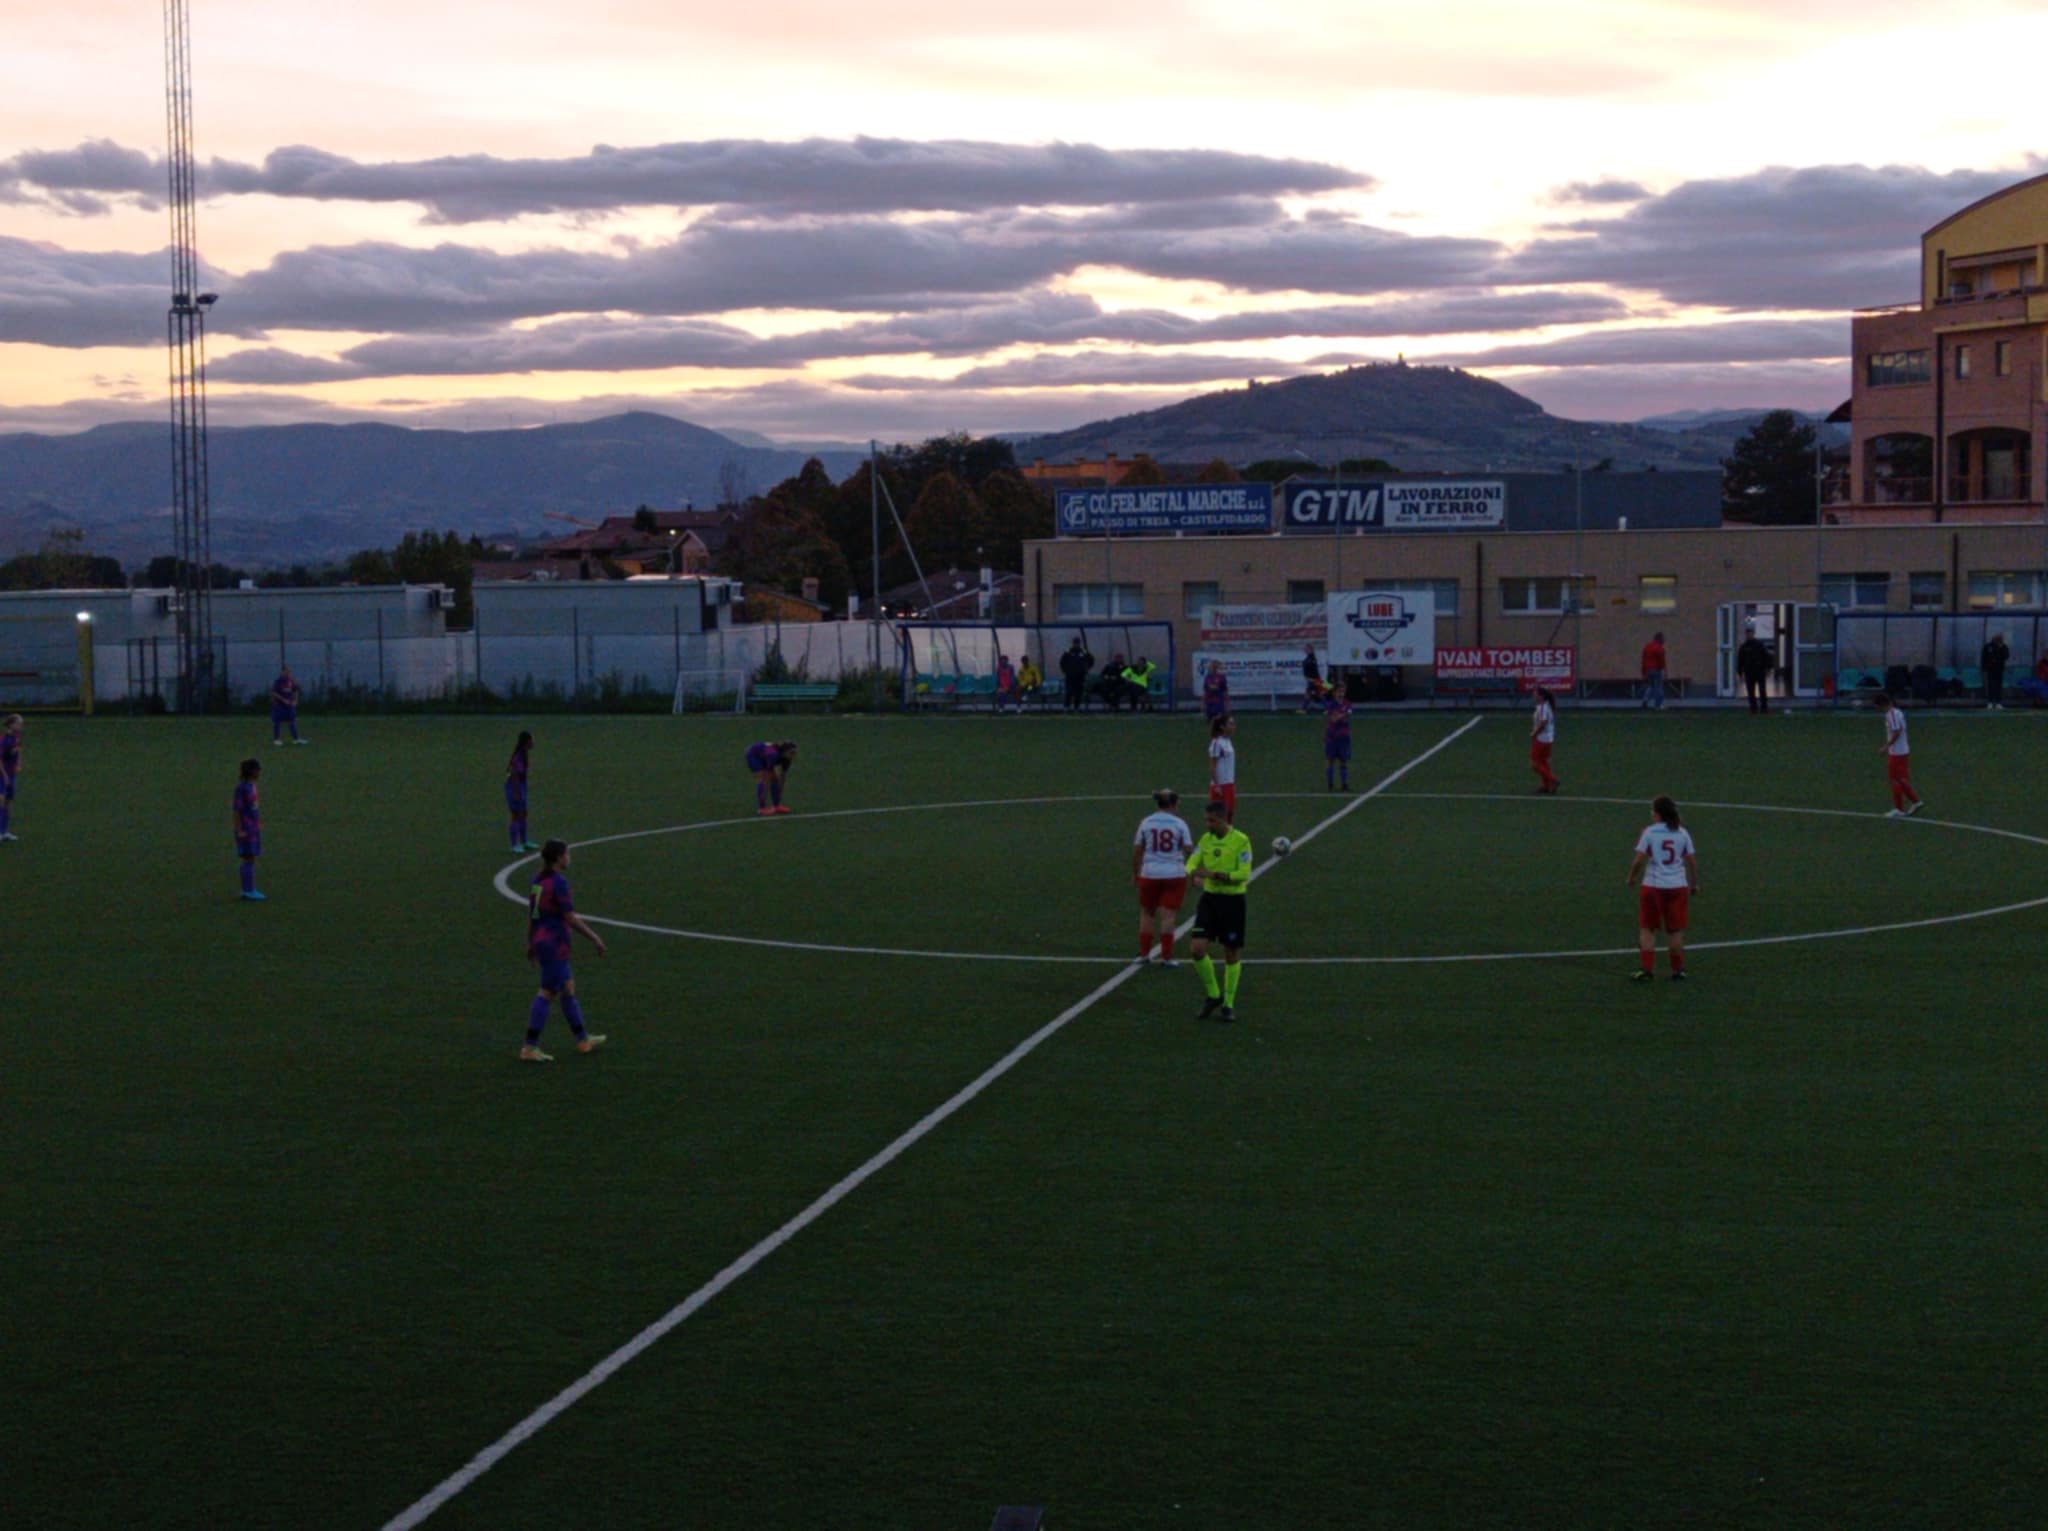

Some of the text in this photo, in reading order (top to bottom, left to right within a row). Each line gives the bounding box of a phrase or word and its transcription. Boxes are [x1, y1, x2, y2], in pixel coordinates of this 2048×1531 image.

[1187, 489, 1247, 512] MARCHE
[1291, 488, 1380, 523] GTM
[1387, 487, 1502, 501] LAVORAZIONI
[1399, 501, 1489, 515] IN FERRO
[1437, 649, 1571, 666] IVAN TOMBESI
[1151, 828, 1173, 852] 18
[1661, 840, 1675, 865] 5
